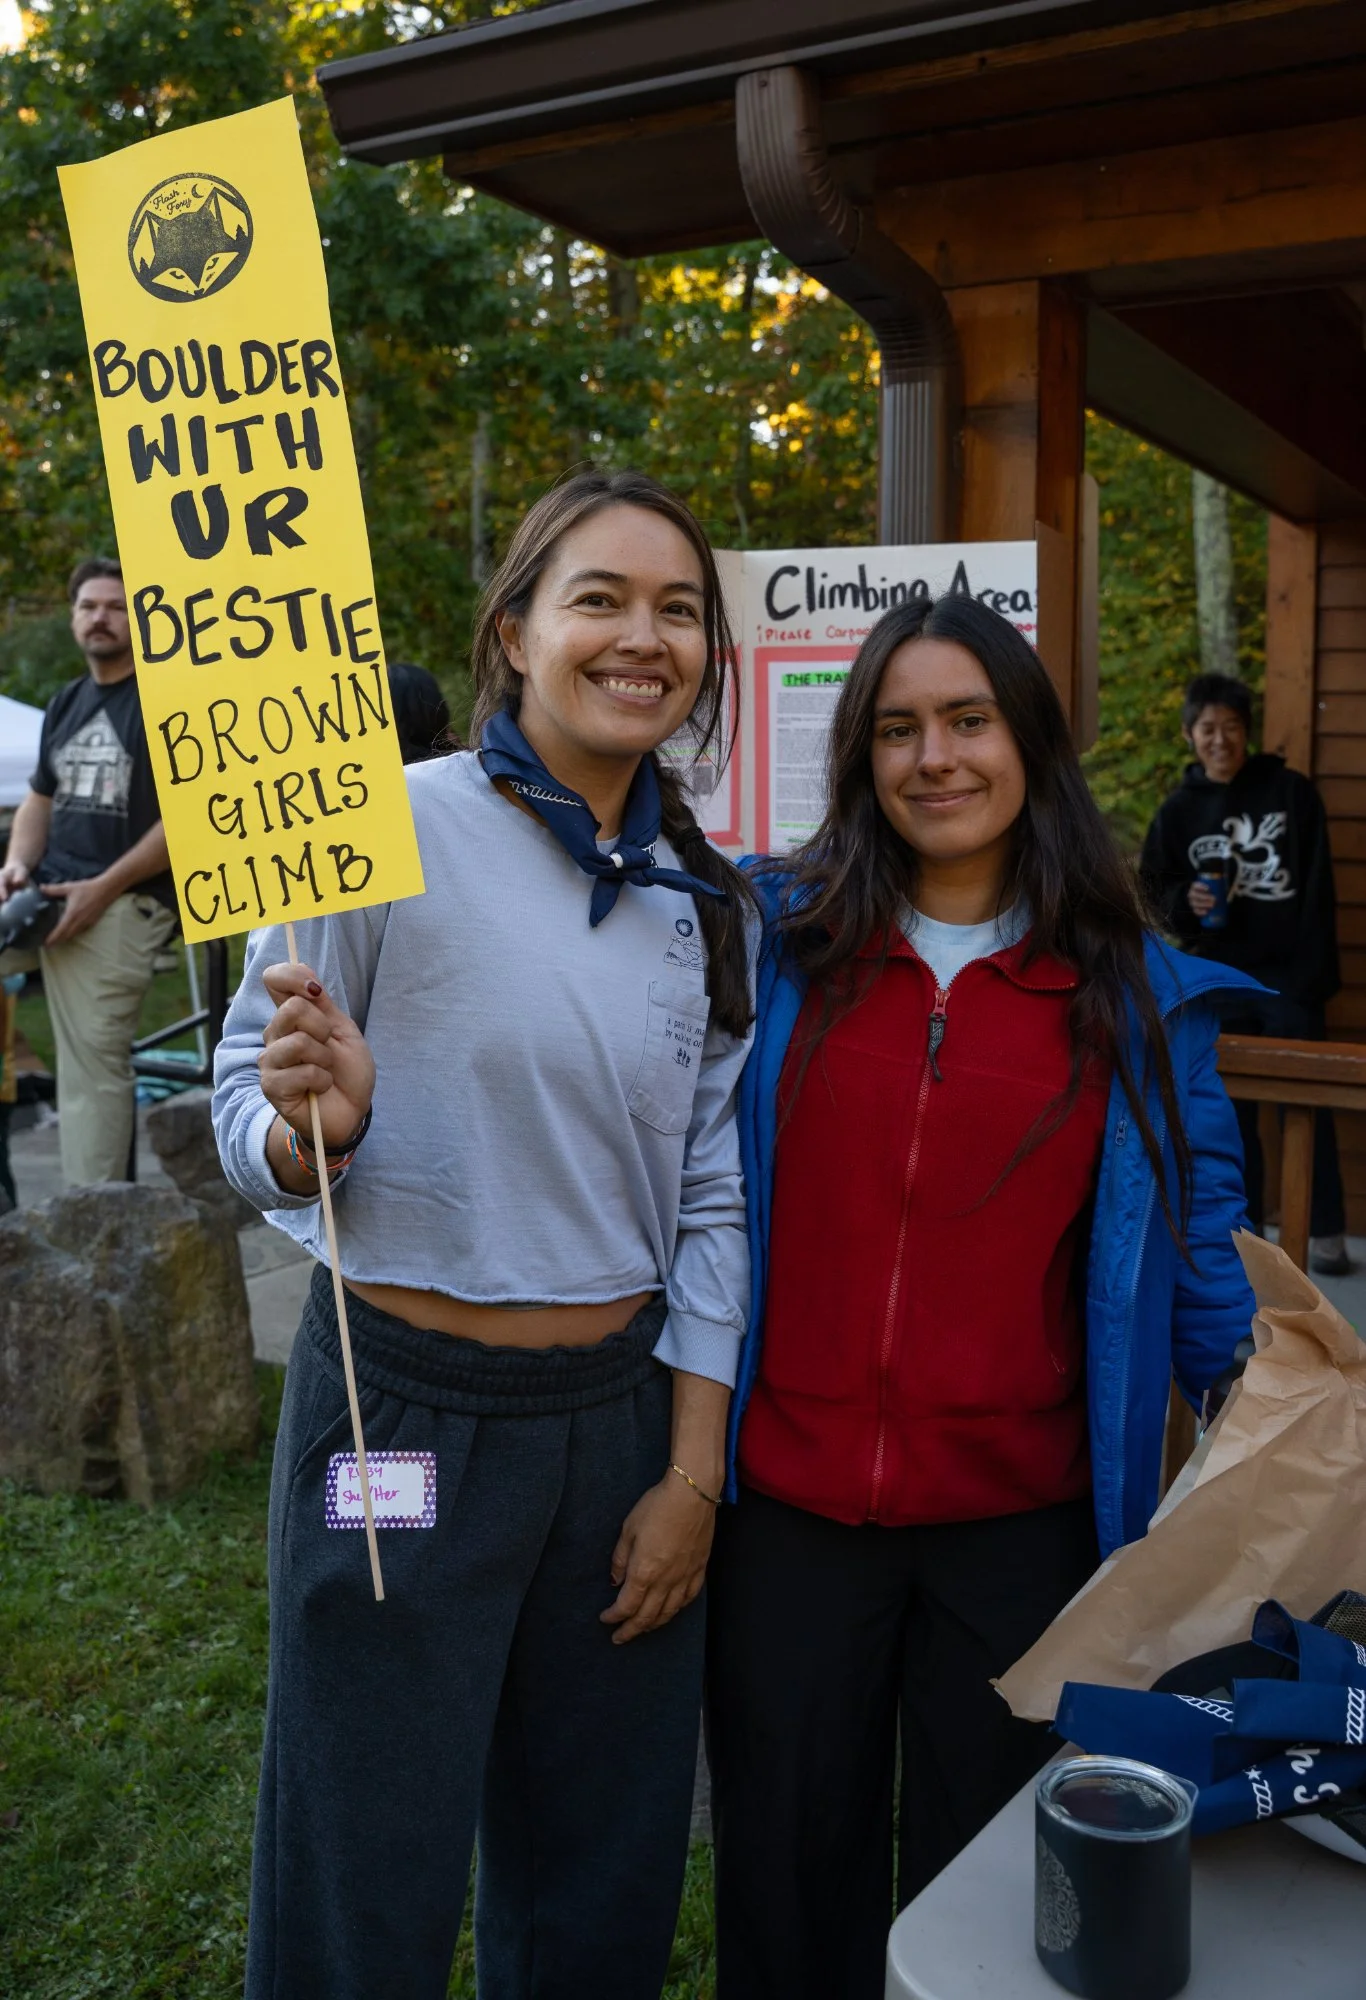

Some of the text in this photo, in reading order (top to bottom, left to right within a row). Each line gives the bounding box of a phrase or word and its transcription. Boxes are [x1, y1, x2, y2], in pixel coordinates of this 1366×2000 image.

[152, 189, 180, 210] Flash
[166, 198, 192, 215] Foxy
[93, 338, 340, 404] BOULDER
[127, 406, 324, 484] WITH
[171, 484, 308, 560] UR
[133, 585, 381, 666] BESTIE
[784, 673, 810, 686] THE
[158, 663, 389, 785] BROWN
[207, 763, 369, 840] GIRLS
[183, 841, 374, 925] CLIMB
[665, 1027, 673, 1039] by
